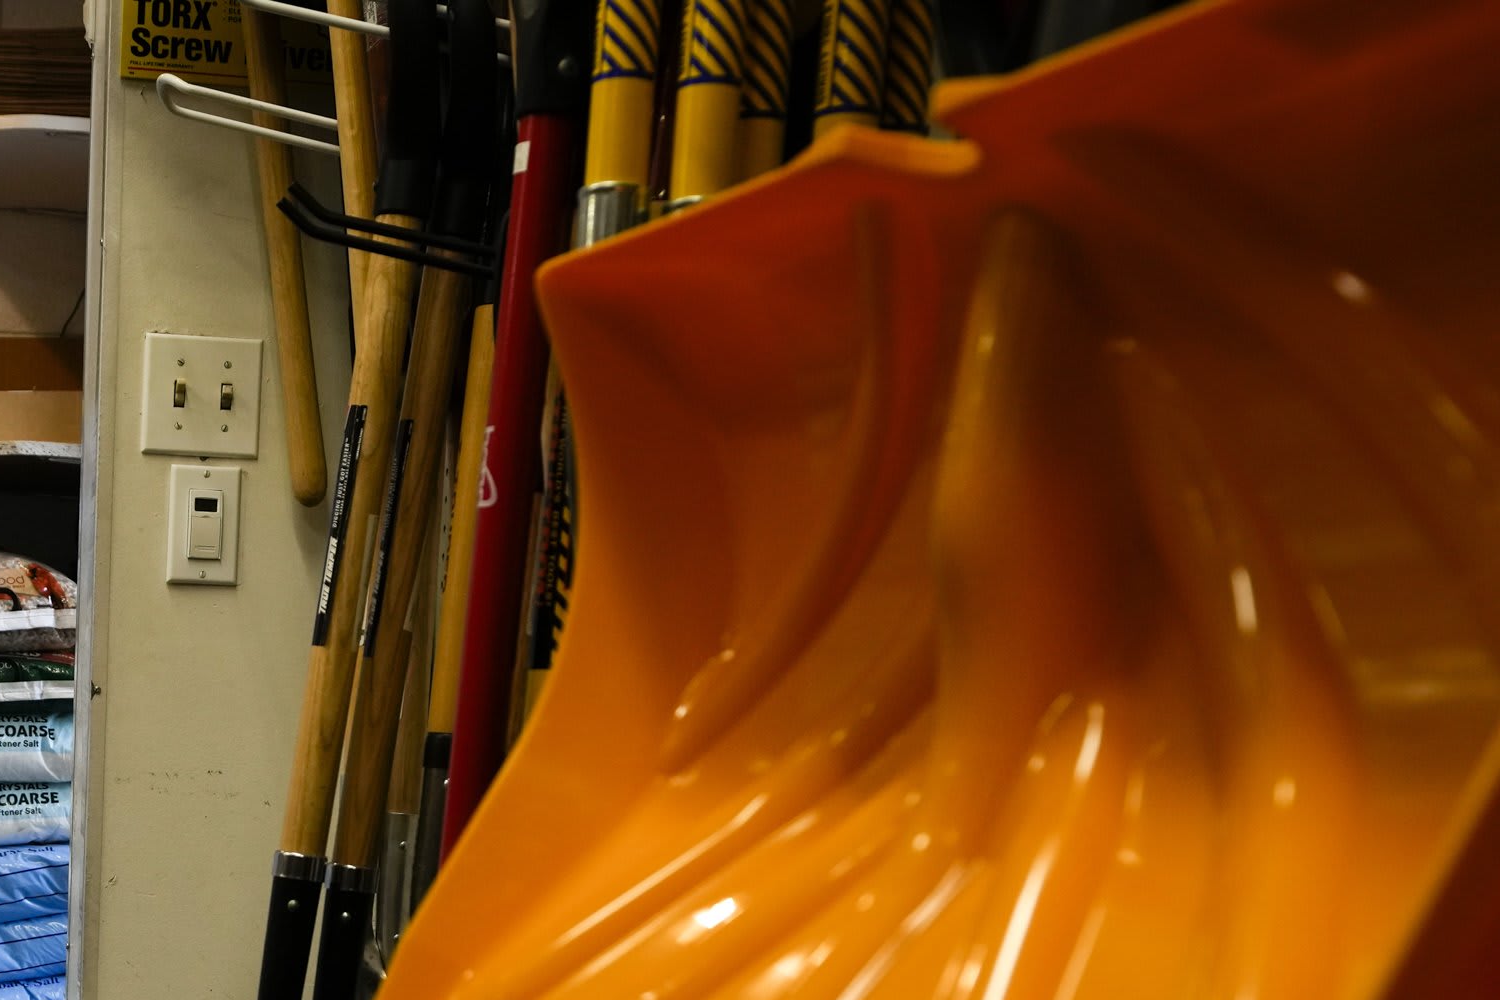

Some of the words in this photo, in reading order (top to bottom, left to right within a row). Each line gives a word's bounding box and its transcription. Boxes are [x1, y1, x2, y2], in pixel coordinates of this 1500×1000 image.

[133, 0, 212, 31] TORX
[130, 27, 233, 64] Screw
[337, 479, 345, 501] JUST
[332, 500, 343, 528] DIGGING
[318, 583, 331, 615] TRUE
[325, 536, 338, 583] TEMPER
